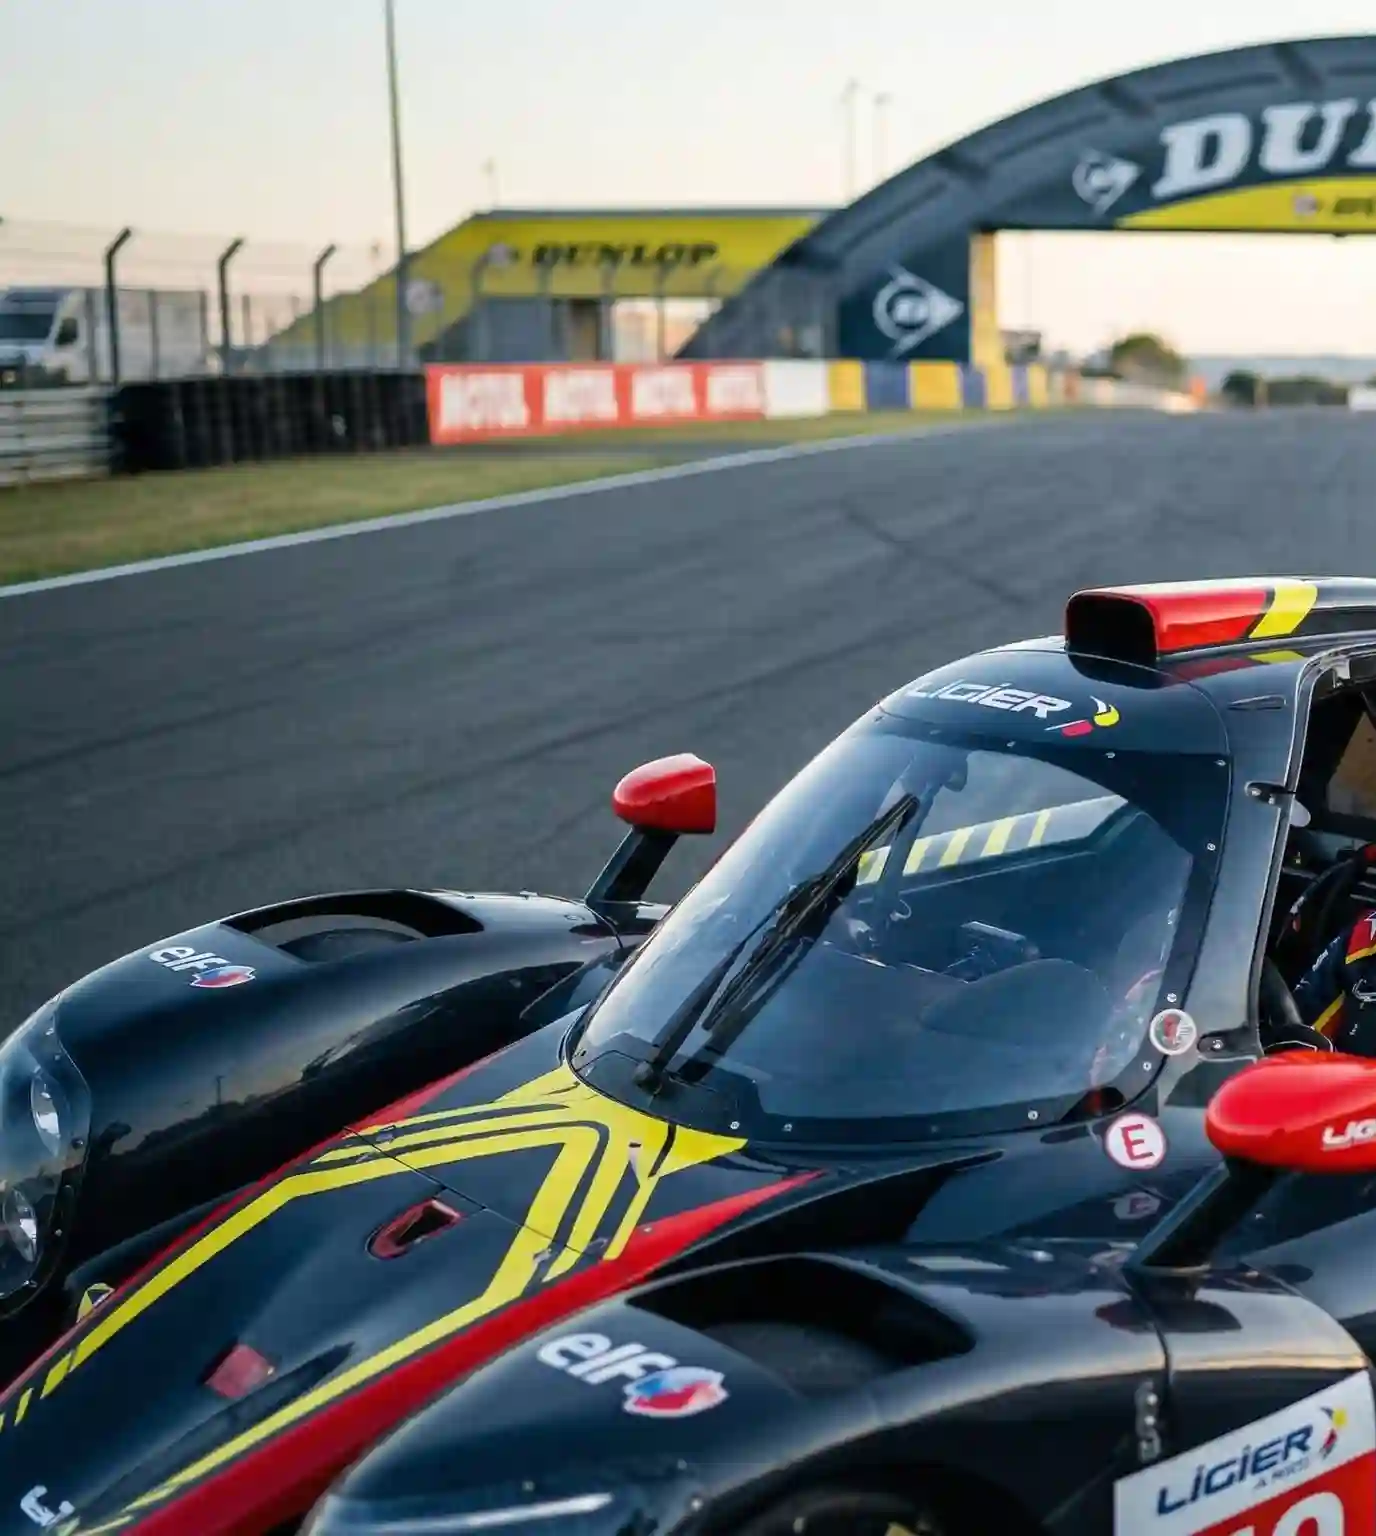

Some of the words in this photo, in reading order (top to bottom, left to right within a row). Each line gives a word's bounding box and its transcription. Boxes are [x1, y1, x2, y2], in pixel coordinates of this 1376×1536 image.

[532, 241, 718, 266] DUNLOP
[149, 946, 231, 972] elf
[536, 1333, 677, 1385] elf
